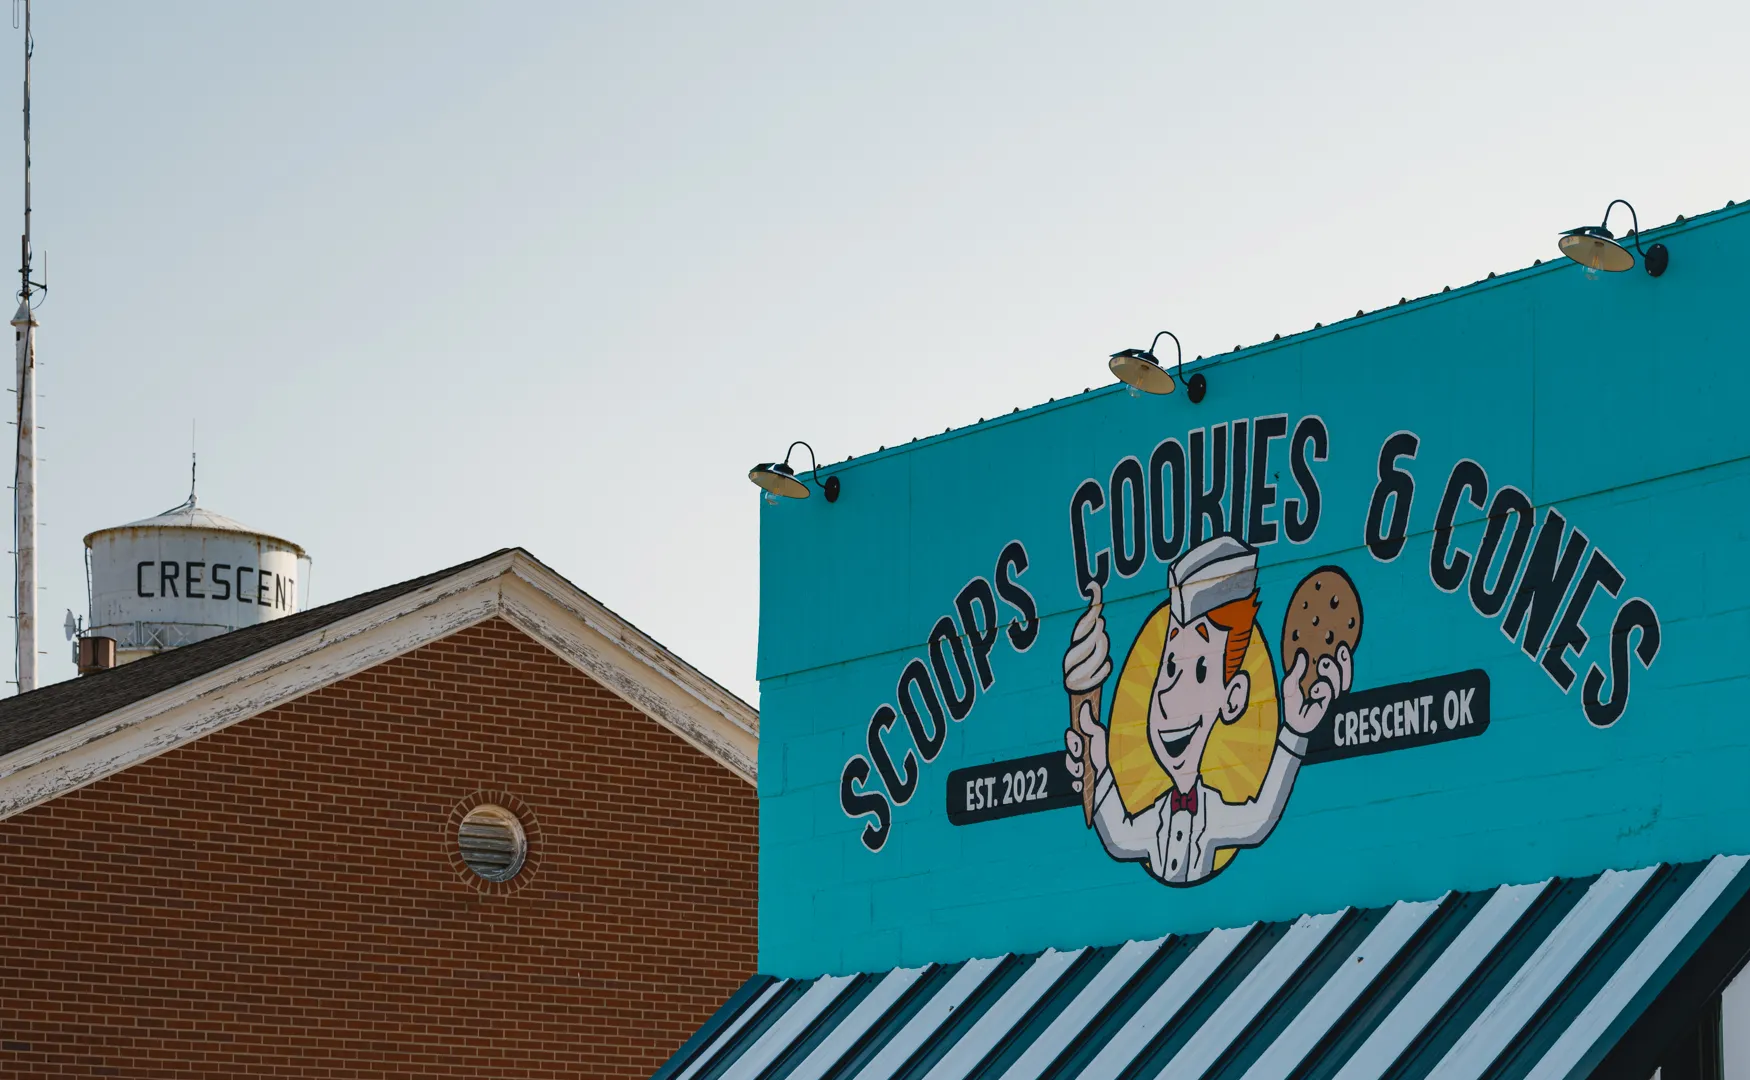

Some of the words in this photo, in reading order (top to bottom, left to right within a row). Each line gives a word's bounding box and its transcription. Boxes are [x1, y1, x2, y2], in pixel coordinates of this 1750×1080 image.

[137, 560, 295, 616] CRESCENT
[840, 539, 1040, 853] SCOOPS
[1070, 413, 1329, 598] COOKIES
[1364, 430, 1421, 563] &
[1429, 458, 1661, 729] CONES
[1334, 695, 1438, 747] CRESCENT,
[1443, 687, 1476, 730] OK
[966, 776, 998, 811] EST.
[1002, 766, 1048, 805] 2022
